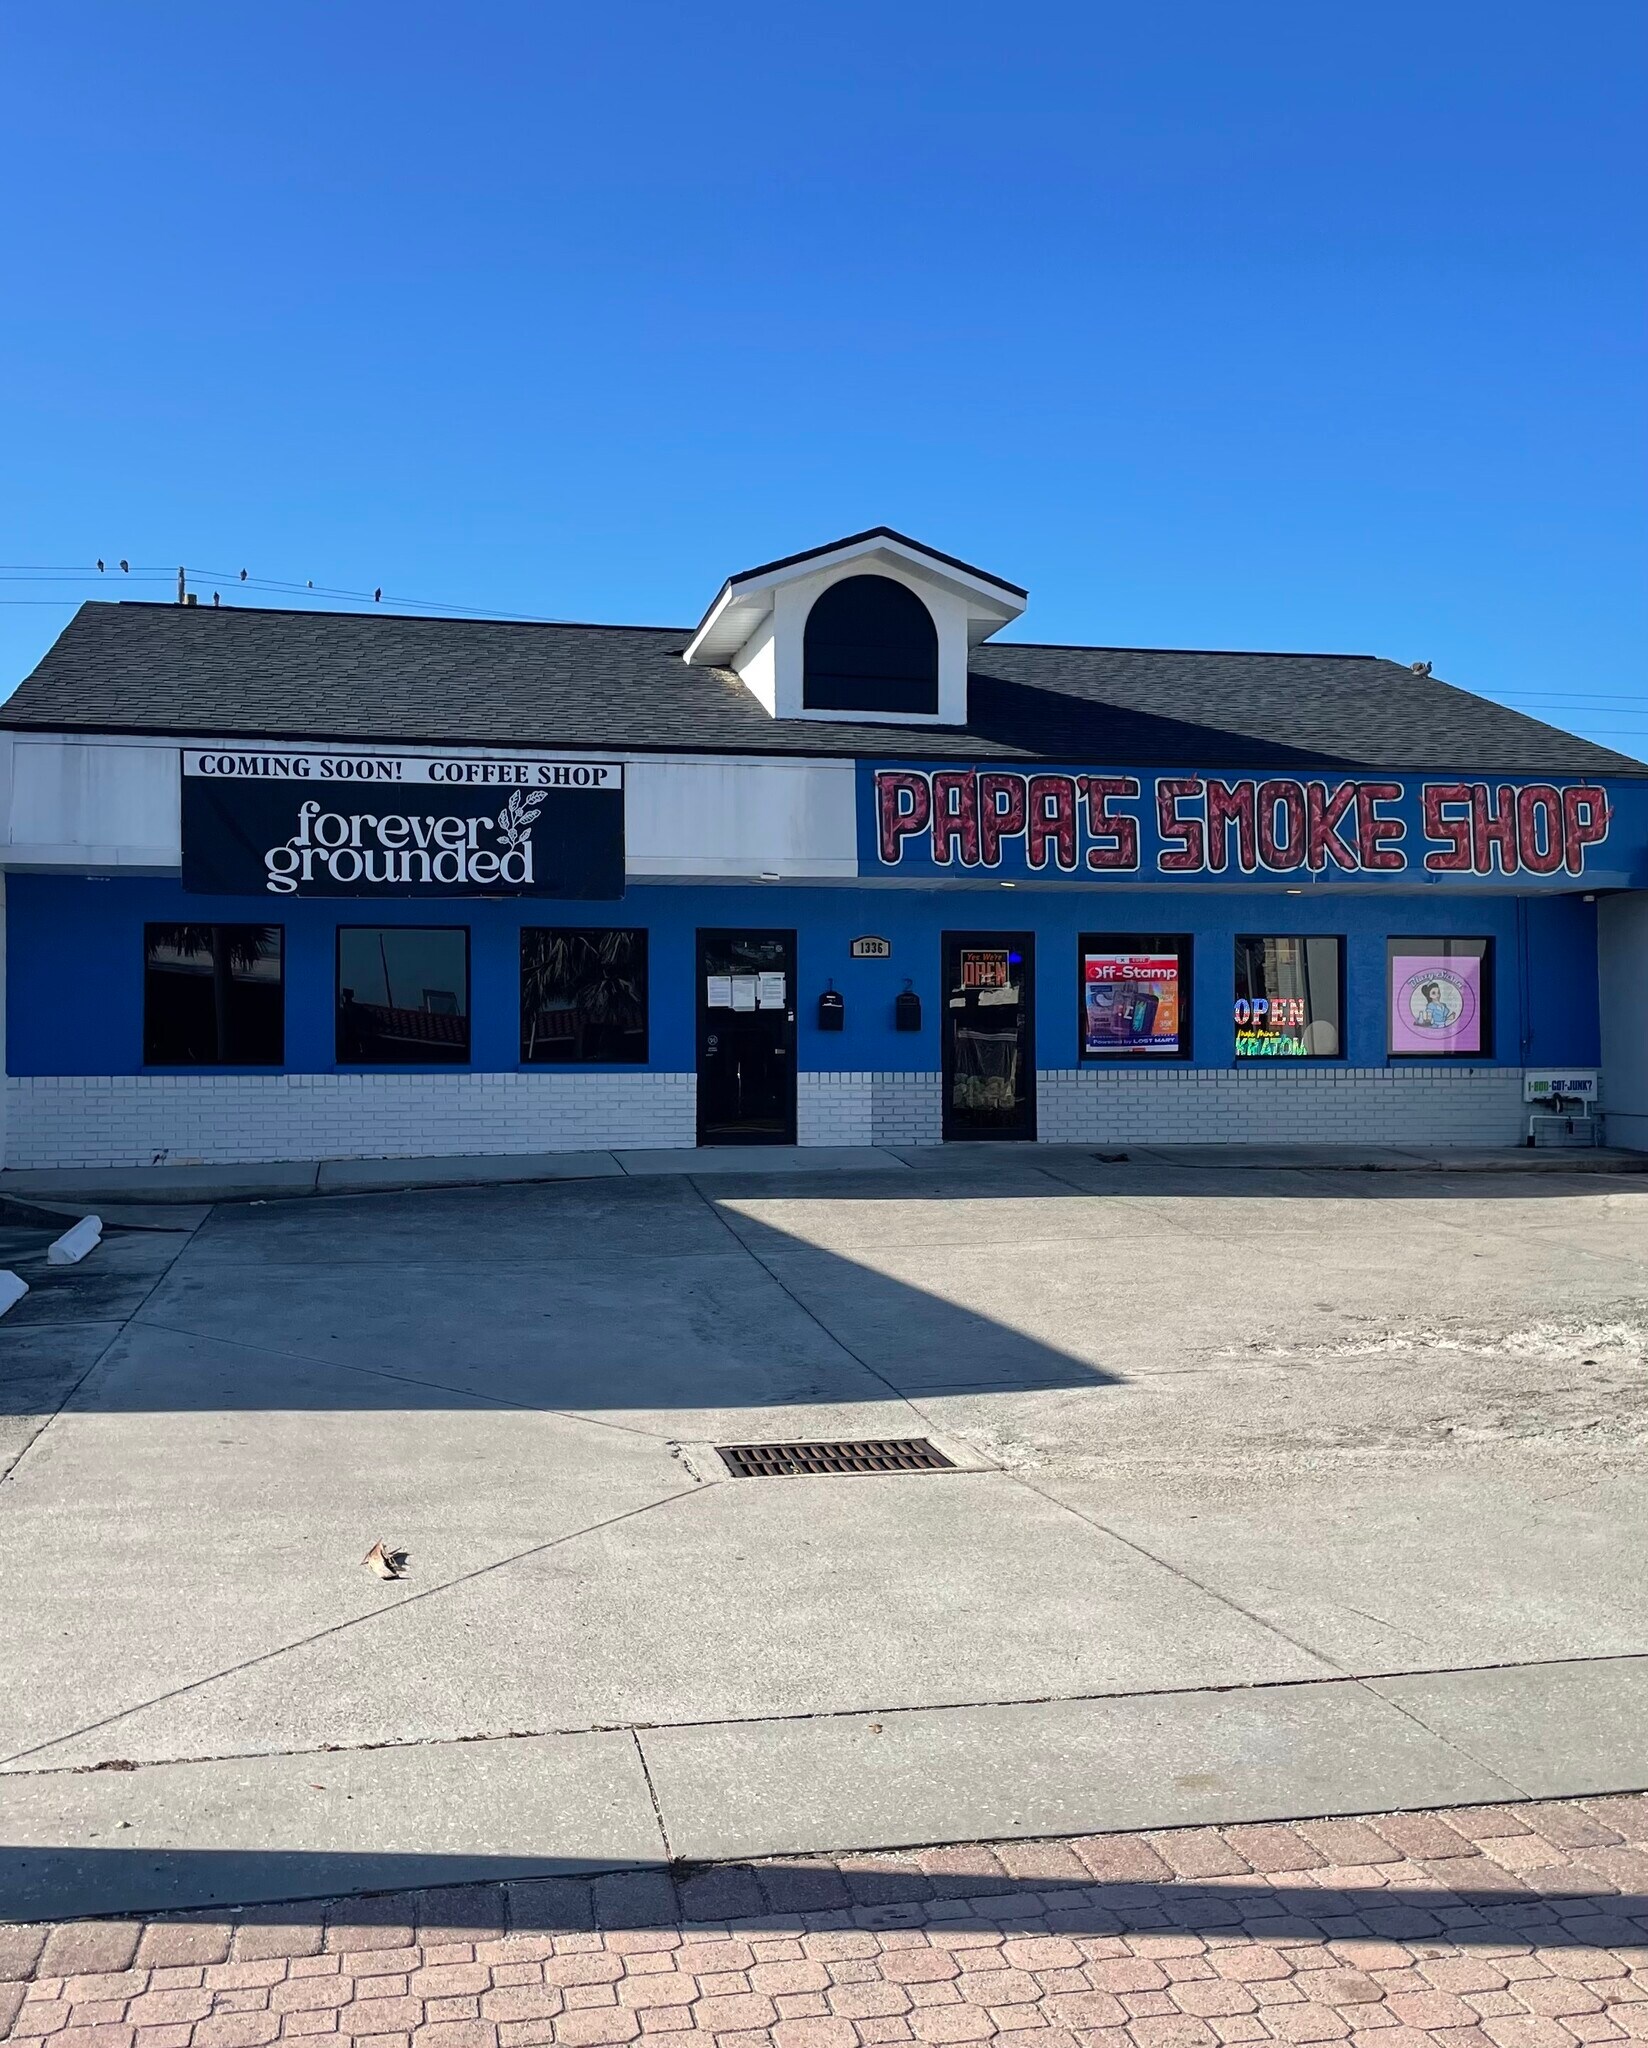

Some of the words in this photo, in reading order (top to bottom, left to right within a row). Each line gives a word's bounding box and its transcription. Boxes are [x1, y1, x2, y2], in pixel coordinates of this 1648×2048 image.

[199, 755, 311, 777] COMING
[320, 759, 402, 779] SOON!
[428, 763, 529, 784] COFFEE
[538, 766, 608, 786] SHOP
[297, 800, 495, 849] forever
[874, 768, 1141, 873] PAPA'S
[1155, 777, 1408, 874] SMOKE
[1422, 781, 1613, 878] SHOP
[264, 837, 535, 893] grounded
[860, 942, 884, 954] 1336
[964, 962, 1006, 986] OPEN
[1089, 965, 1178, 981] Off-Stamp
[1234, 998, 1304, 1026] OPEN
[1235, 1037, 1308, 1056] KRATOM
